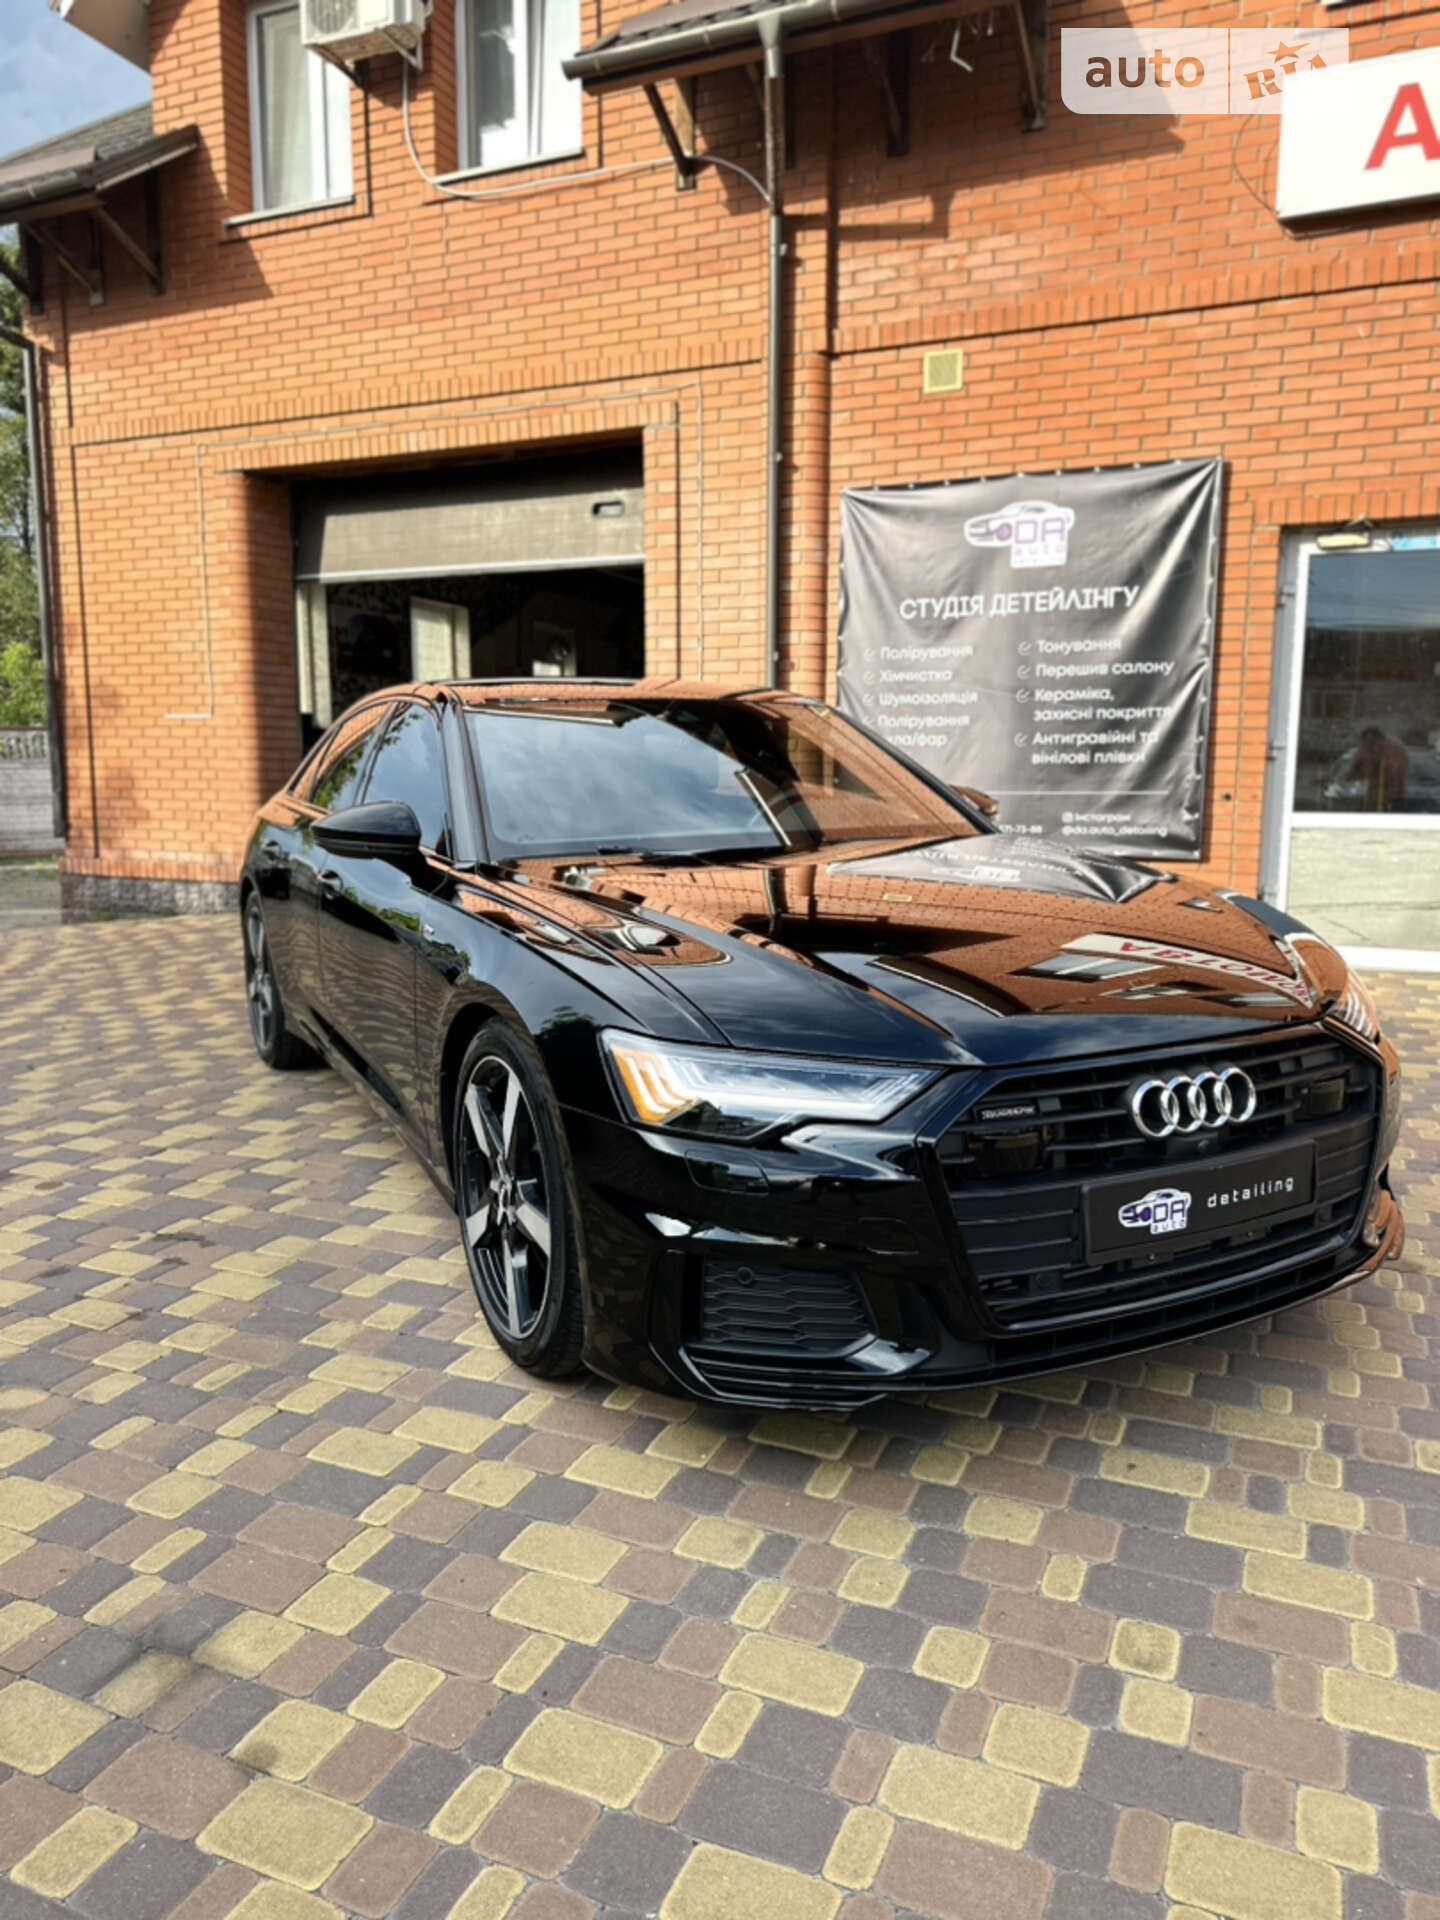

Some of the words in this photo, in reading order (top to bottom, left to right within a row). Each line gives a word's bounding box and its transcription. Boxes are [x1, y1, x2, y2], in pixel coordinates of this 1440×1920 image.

[899, 594, 984, 620] СТУДІЯ
[990, 585, 1140, 617] ДЕТЕЙЛІНГУ
[880, 646, 974, 662] Полірування
[1038, 639, 1122, 656] Тонування
[880, 669, 953, 682] Хімчистка
[1036, 662, 1109, 679] Перешив
[1111, 660, 1175, 677] салону
[1033, 706, 1094, 721] захисні
[878, 714, 970, 730] Полірування
[1207, 1177, 1294, 1208] detailing
